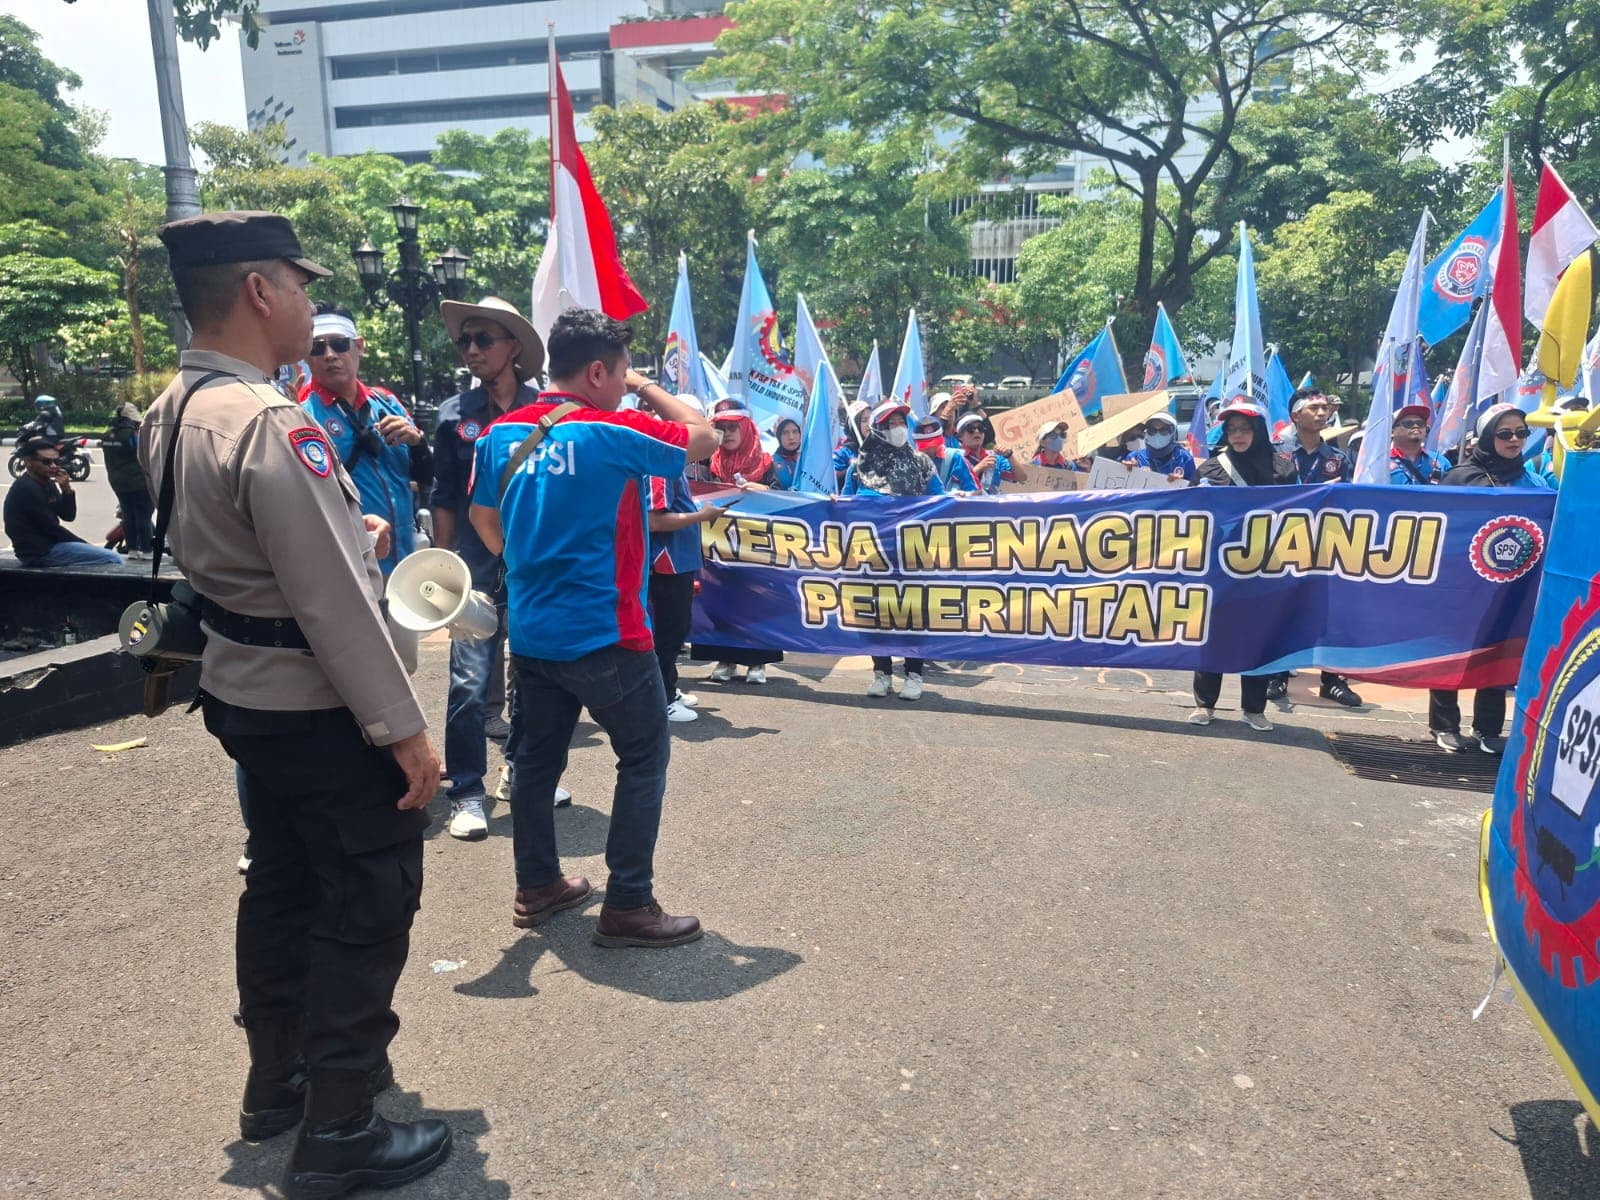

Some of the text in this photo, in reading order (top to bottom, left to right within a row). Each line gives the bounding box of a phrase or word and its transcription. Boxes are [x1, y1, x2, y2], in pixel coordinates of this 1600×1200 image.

[700, 511, 1443, 581] KERJA MENAGIH JANJI
[1497, 544, 1517, 556] SPSI
[800, 578, 1210, 643] PEMERINTAH
